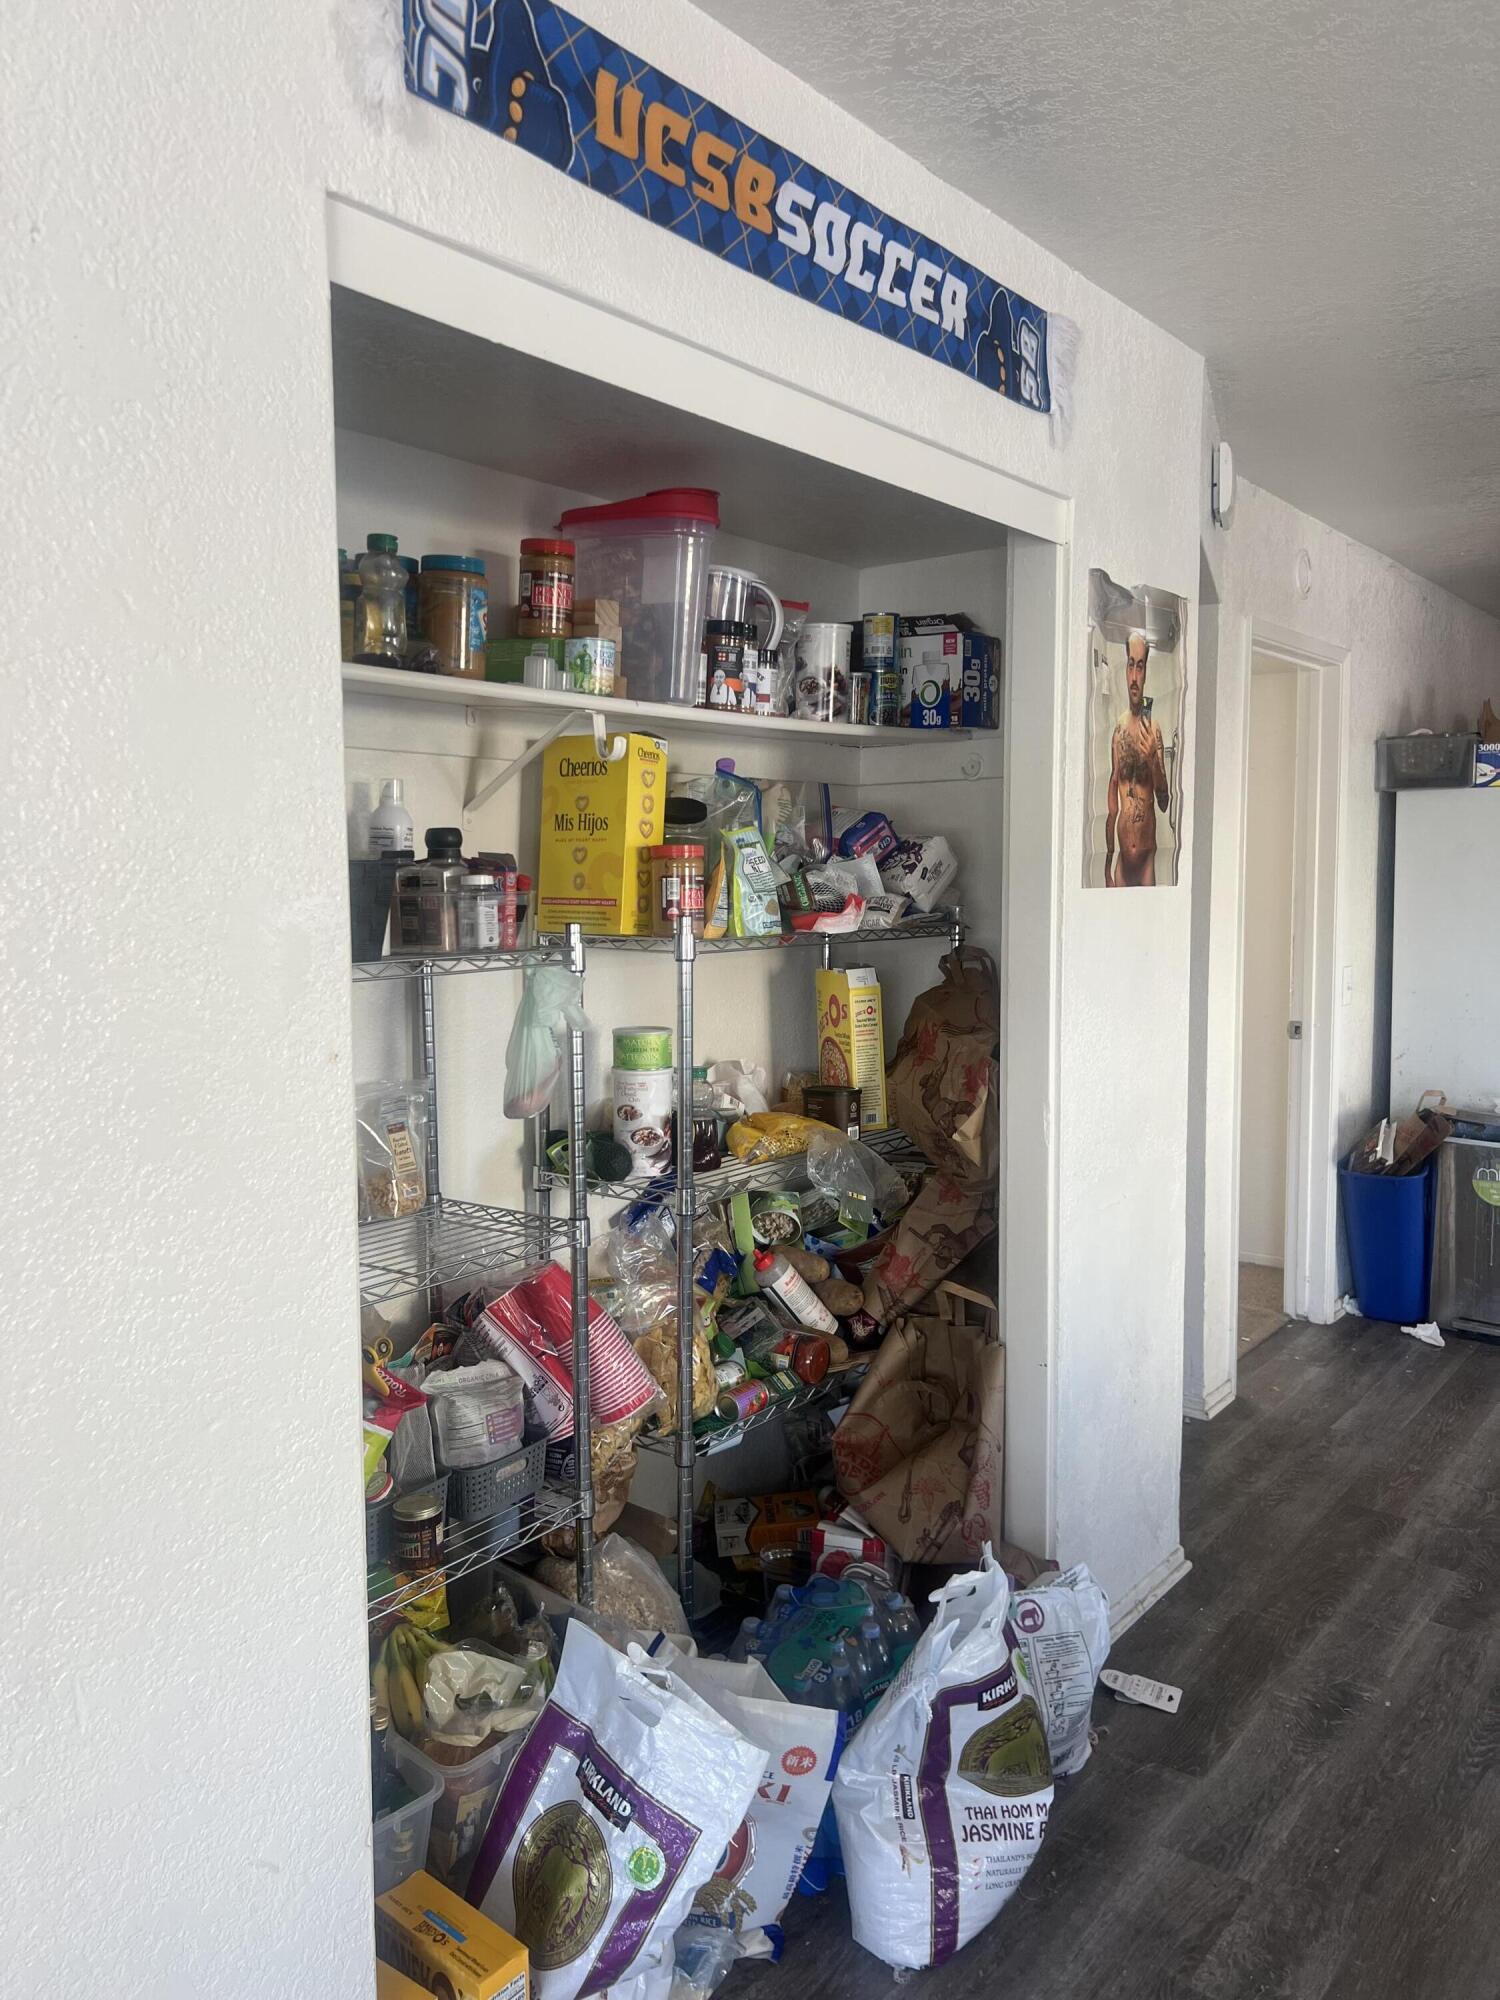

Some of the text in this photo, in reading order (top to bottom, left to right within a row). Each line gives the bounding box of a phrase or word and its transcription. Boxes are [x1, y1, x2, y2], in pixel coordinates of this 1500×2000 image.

[594, 67, 969, 341] UCSB SOCCER
[922, 709, 942, 726] 30g
[637, 747, 660, 760] Cheerios
[559, 758, 608, 777] Cheerios
[554, 814, 609, 836] Mis Hijos
[458, 1375, 483, 1384] ORGANIC
[582, 1758, 632, 1817] KIRKLAND
[904, 1775, 914, 1819] KIRKLAND
[964, 1806, 998, 1821] THAI
[1002, 1805, 1031, 1820] HOM
[962, 1822, 1035, 1843] JASMINE
[985, 1854, 1026, 1865] THAILAND'S
[985, 1866, 1023, 1877] NATURALLY
[985, 1879, 1004, 1891] LONG
